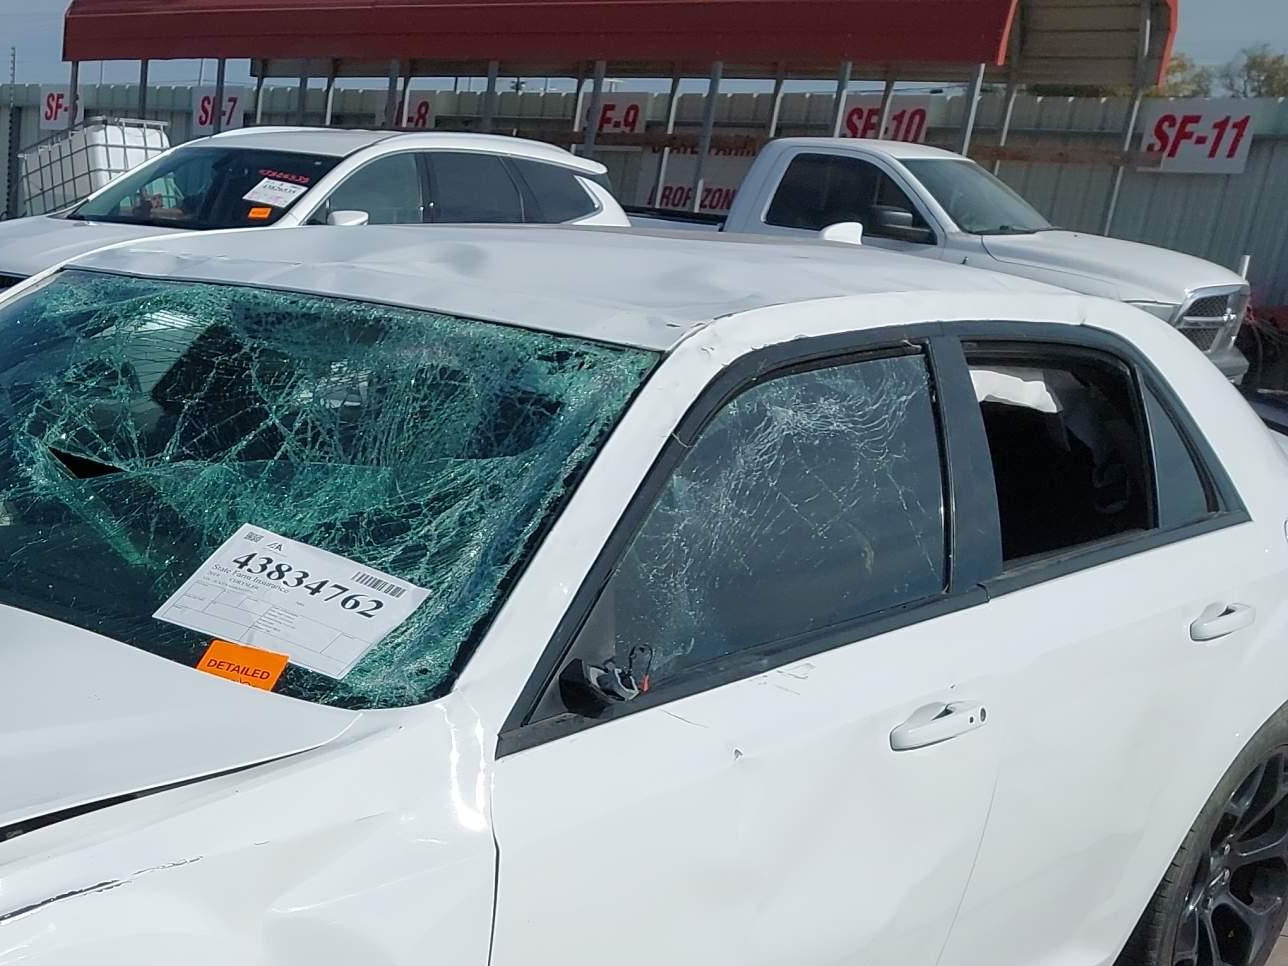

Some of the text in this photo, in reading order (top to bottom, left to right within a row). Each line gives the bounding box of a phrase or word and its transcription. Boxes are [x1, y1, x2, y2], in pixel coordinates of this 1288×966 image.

[584, 103, 640, 134] F-9
[1146, 113, 1251, 159] SF-11
[699, 186, 739, 210] ZON
[212, 563, 231, 574] State
[232, 570, 254, 582] Farm
[253, 576, 290, 594] Insurance
[232, 552, 384, 619] 43834762
[206, 658, 271, 681] DETAILED
